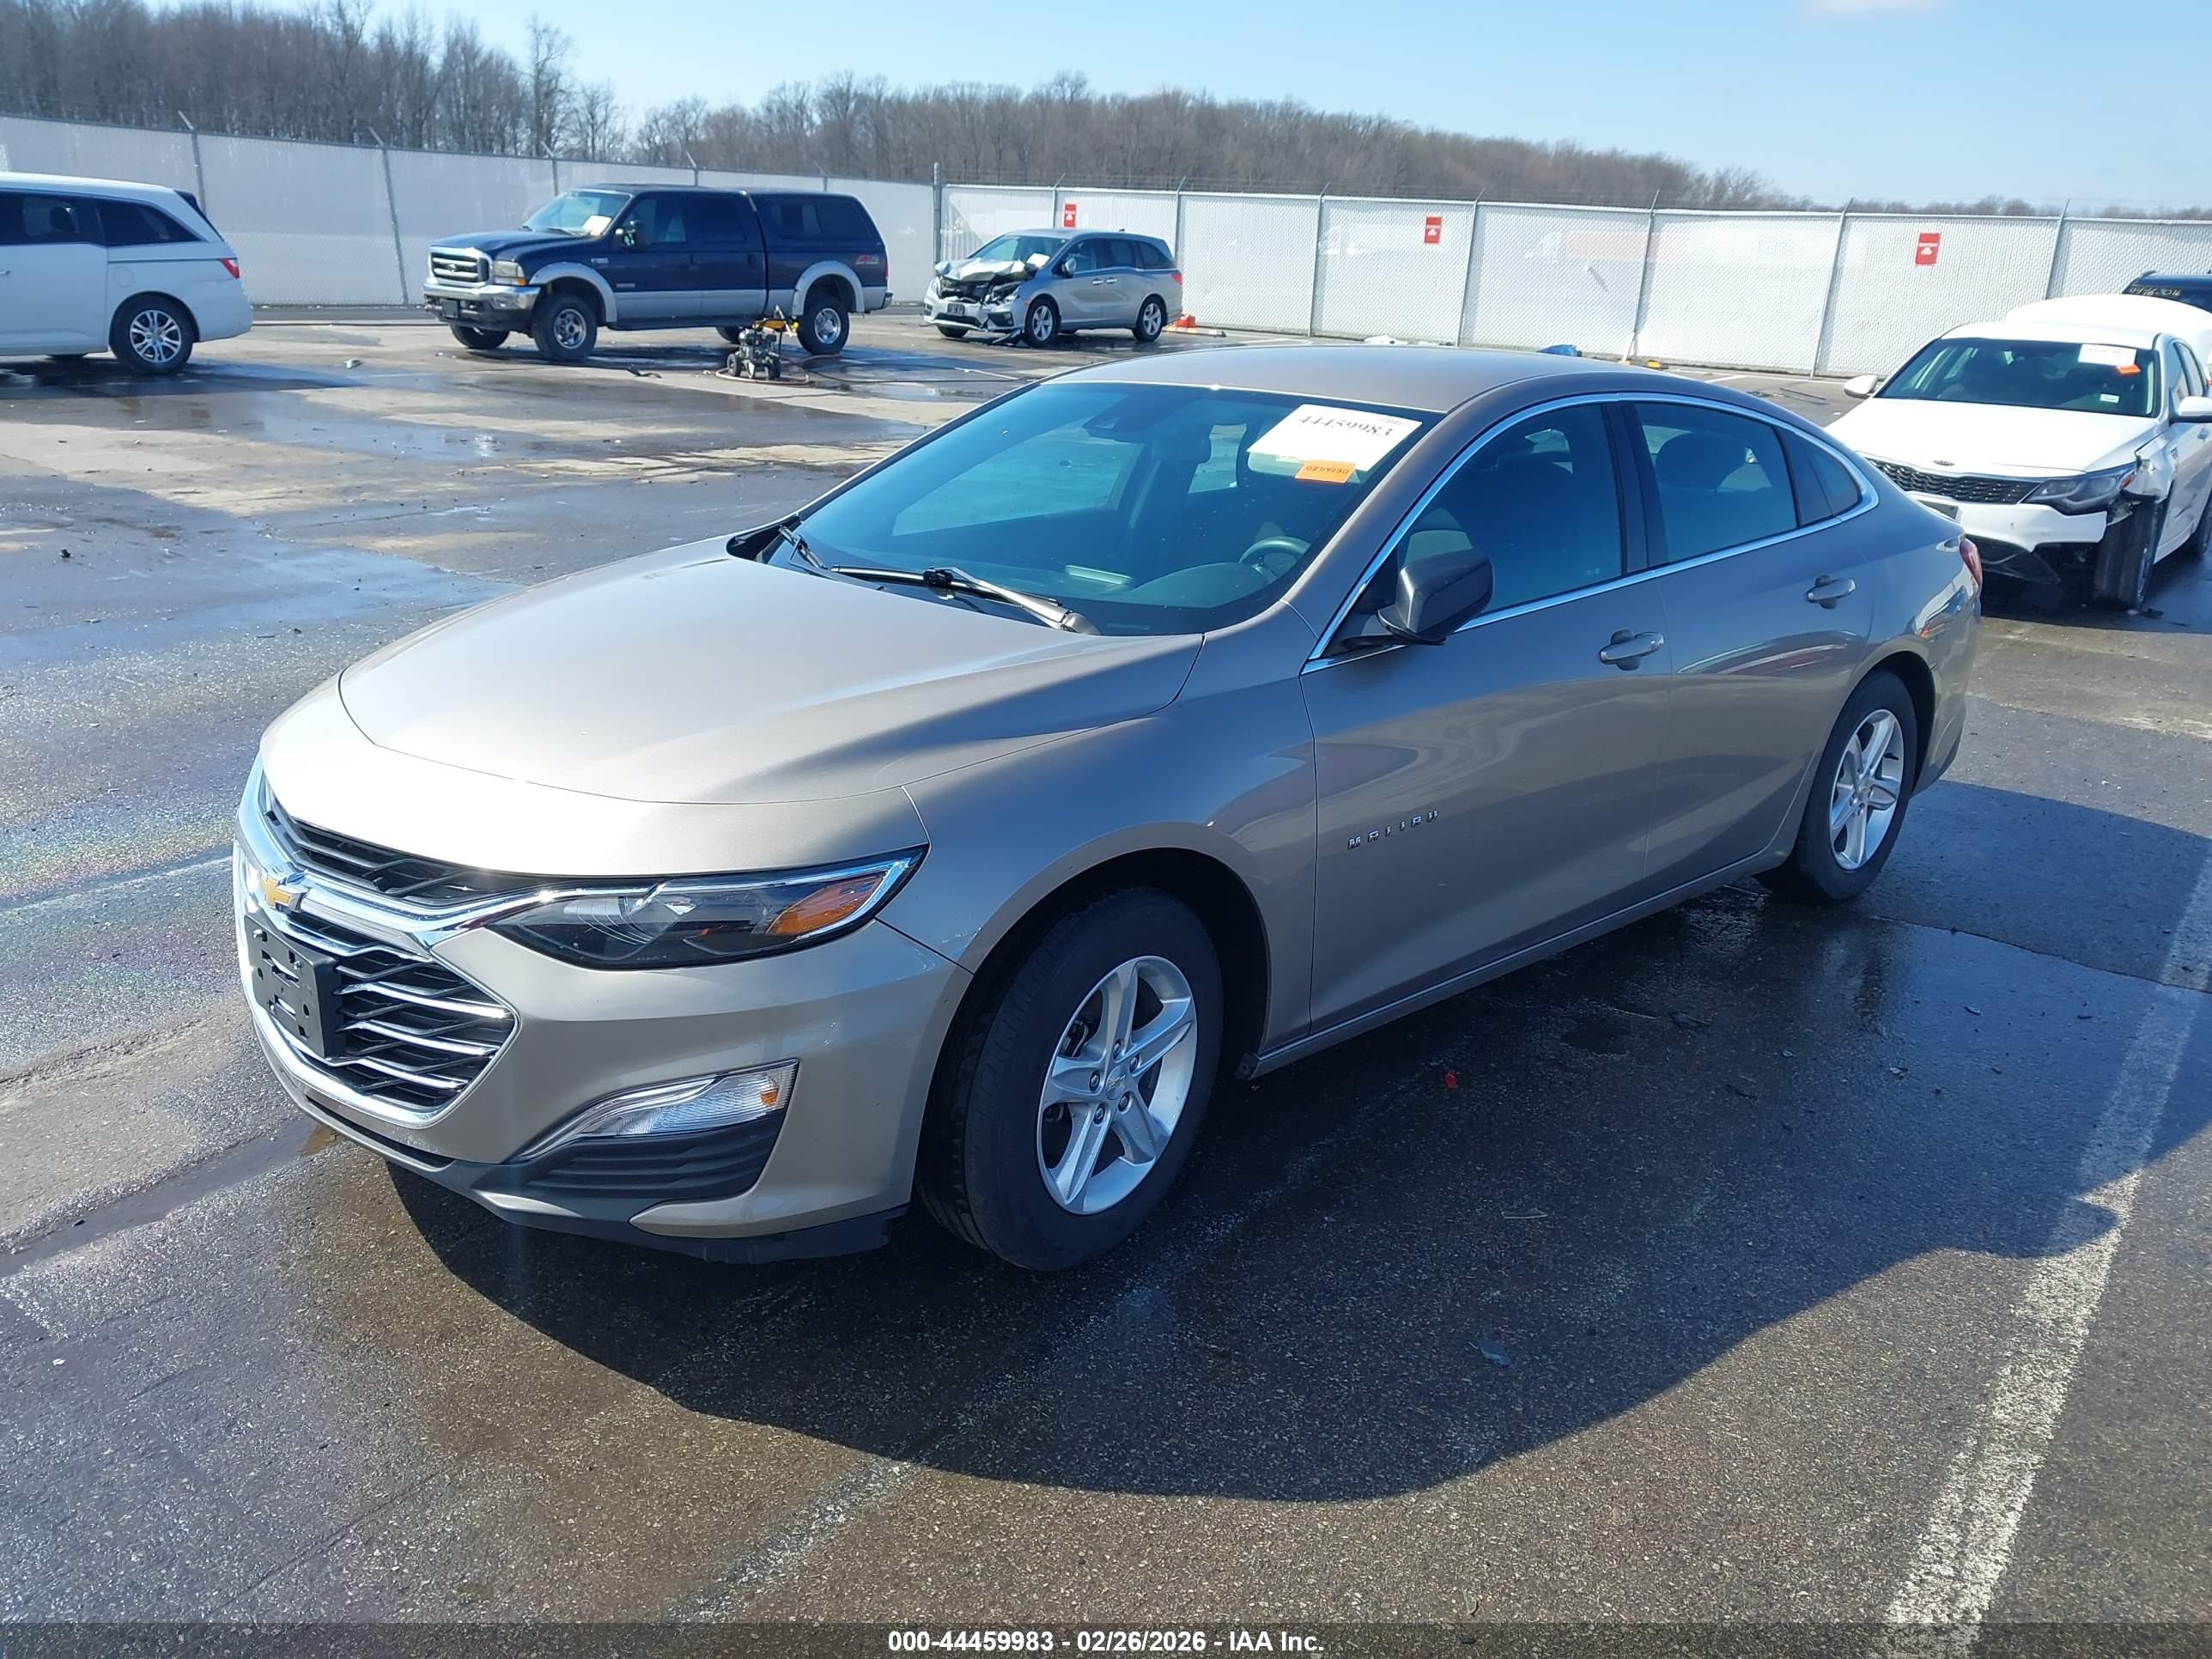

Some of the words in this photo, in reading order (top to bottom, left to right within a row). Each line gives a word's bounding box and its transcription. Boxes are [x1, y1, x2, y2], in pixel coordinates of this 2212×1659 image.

[1298, 415, 1394, 436] 44459983
[1305, 466, 1350, 475] DETAILED
[1347, 810, 1438, 849] MALIBU
